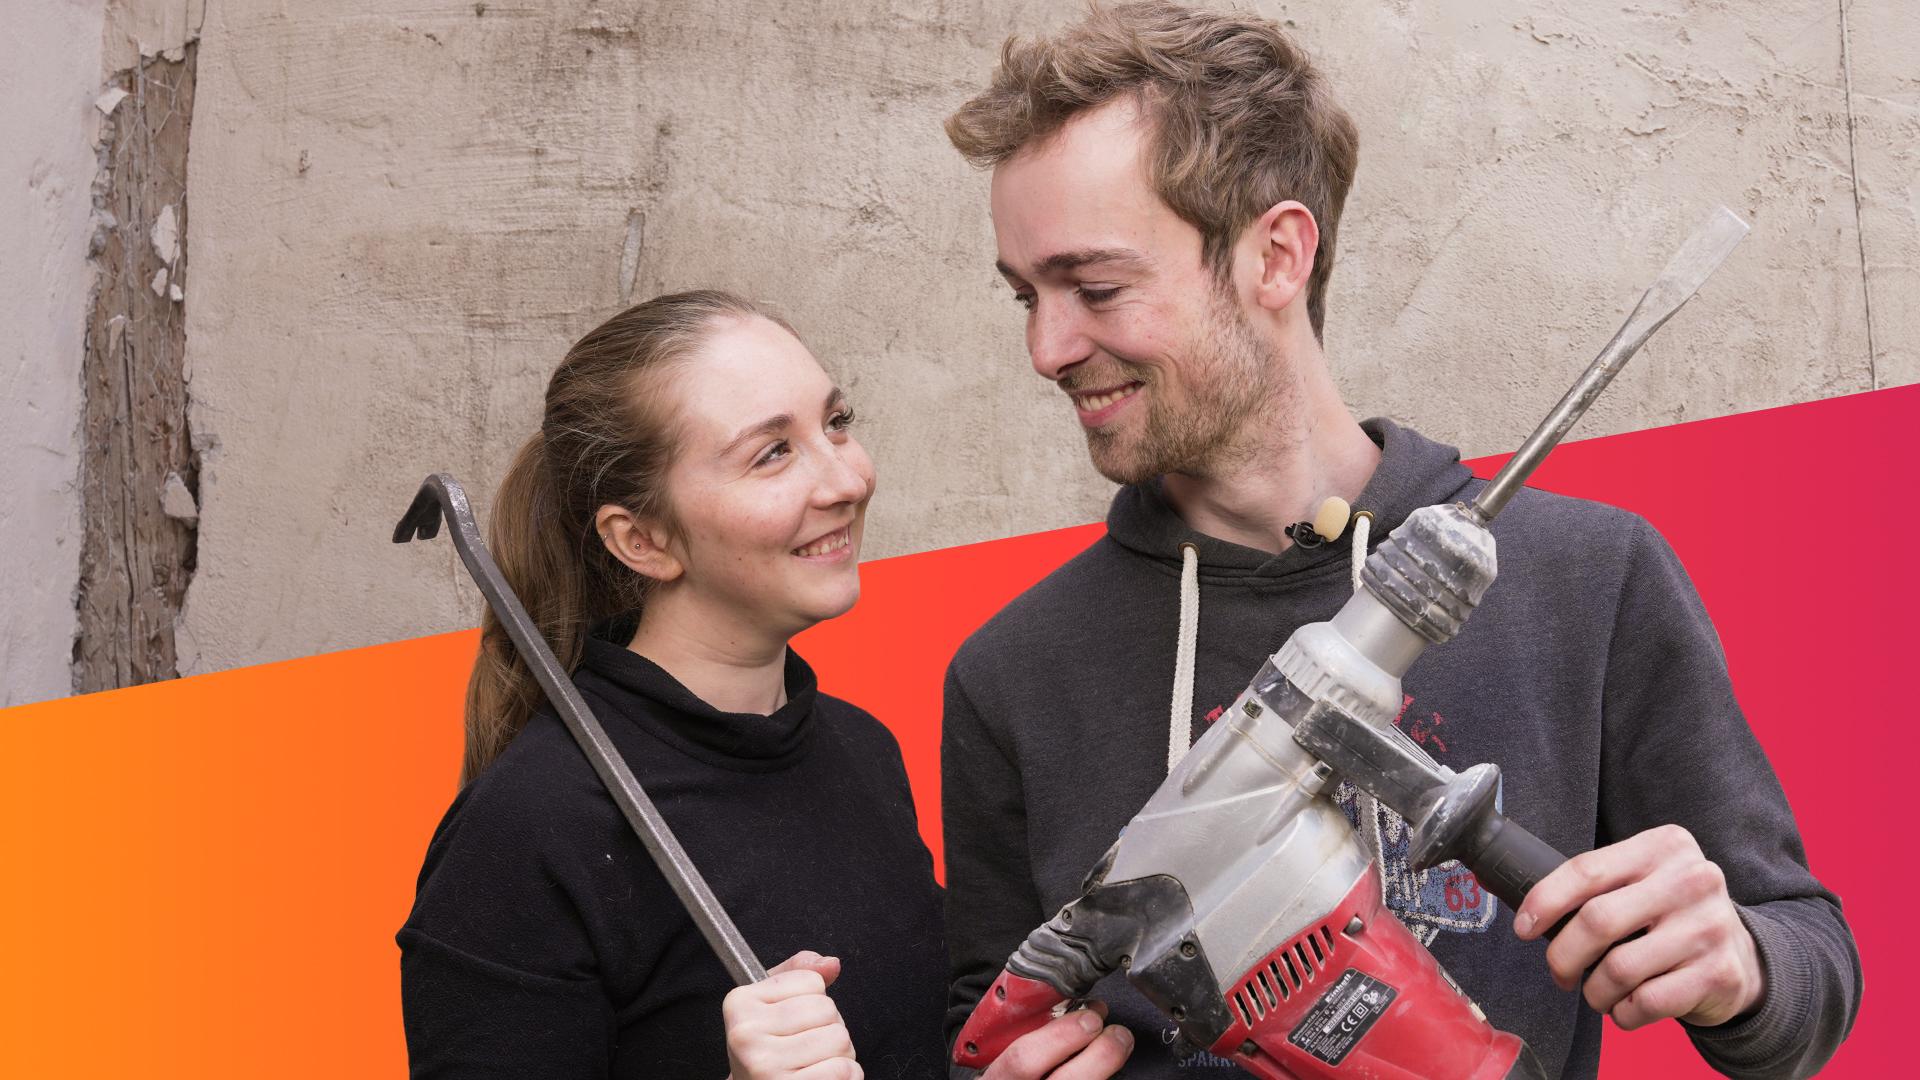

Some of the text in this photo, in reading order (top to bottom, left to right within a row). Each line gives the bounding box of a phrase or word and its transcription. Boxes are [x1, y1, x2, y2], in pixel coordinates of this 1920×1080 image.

[1444, 872, 1482, 912] 63
[1325, 973, 1352, 1003] Einhell
[1341, 1014, 1358, 1032] CE
[1178, 1050, 1236, 1068] SPARK
